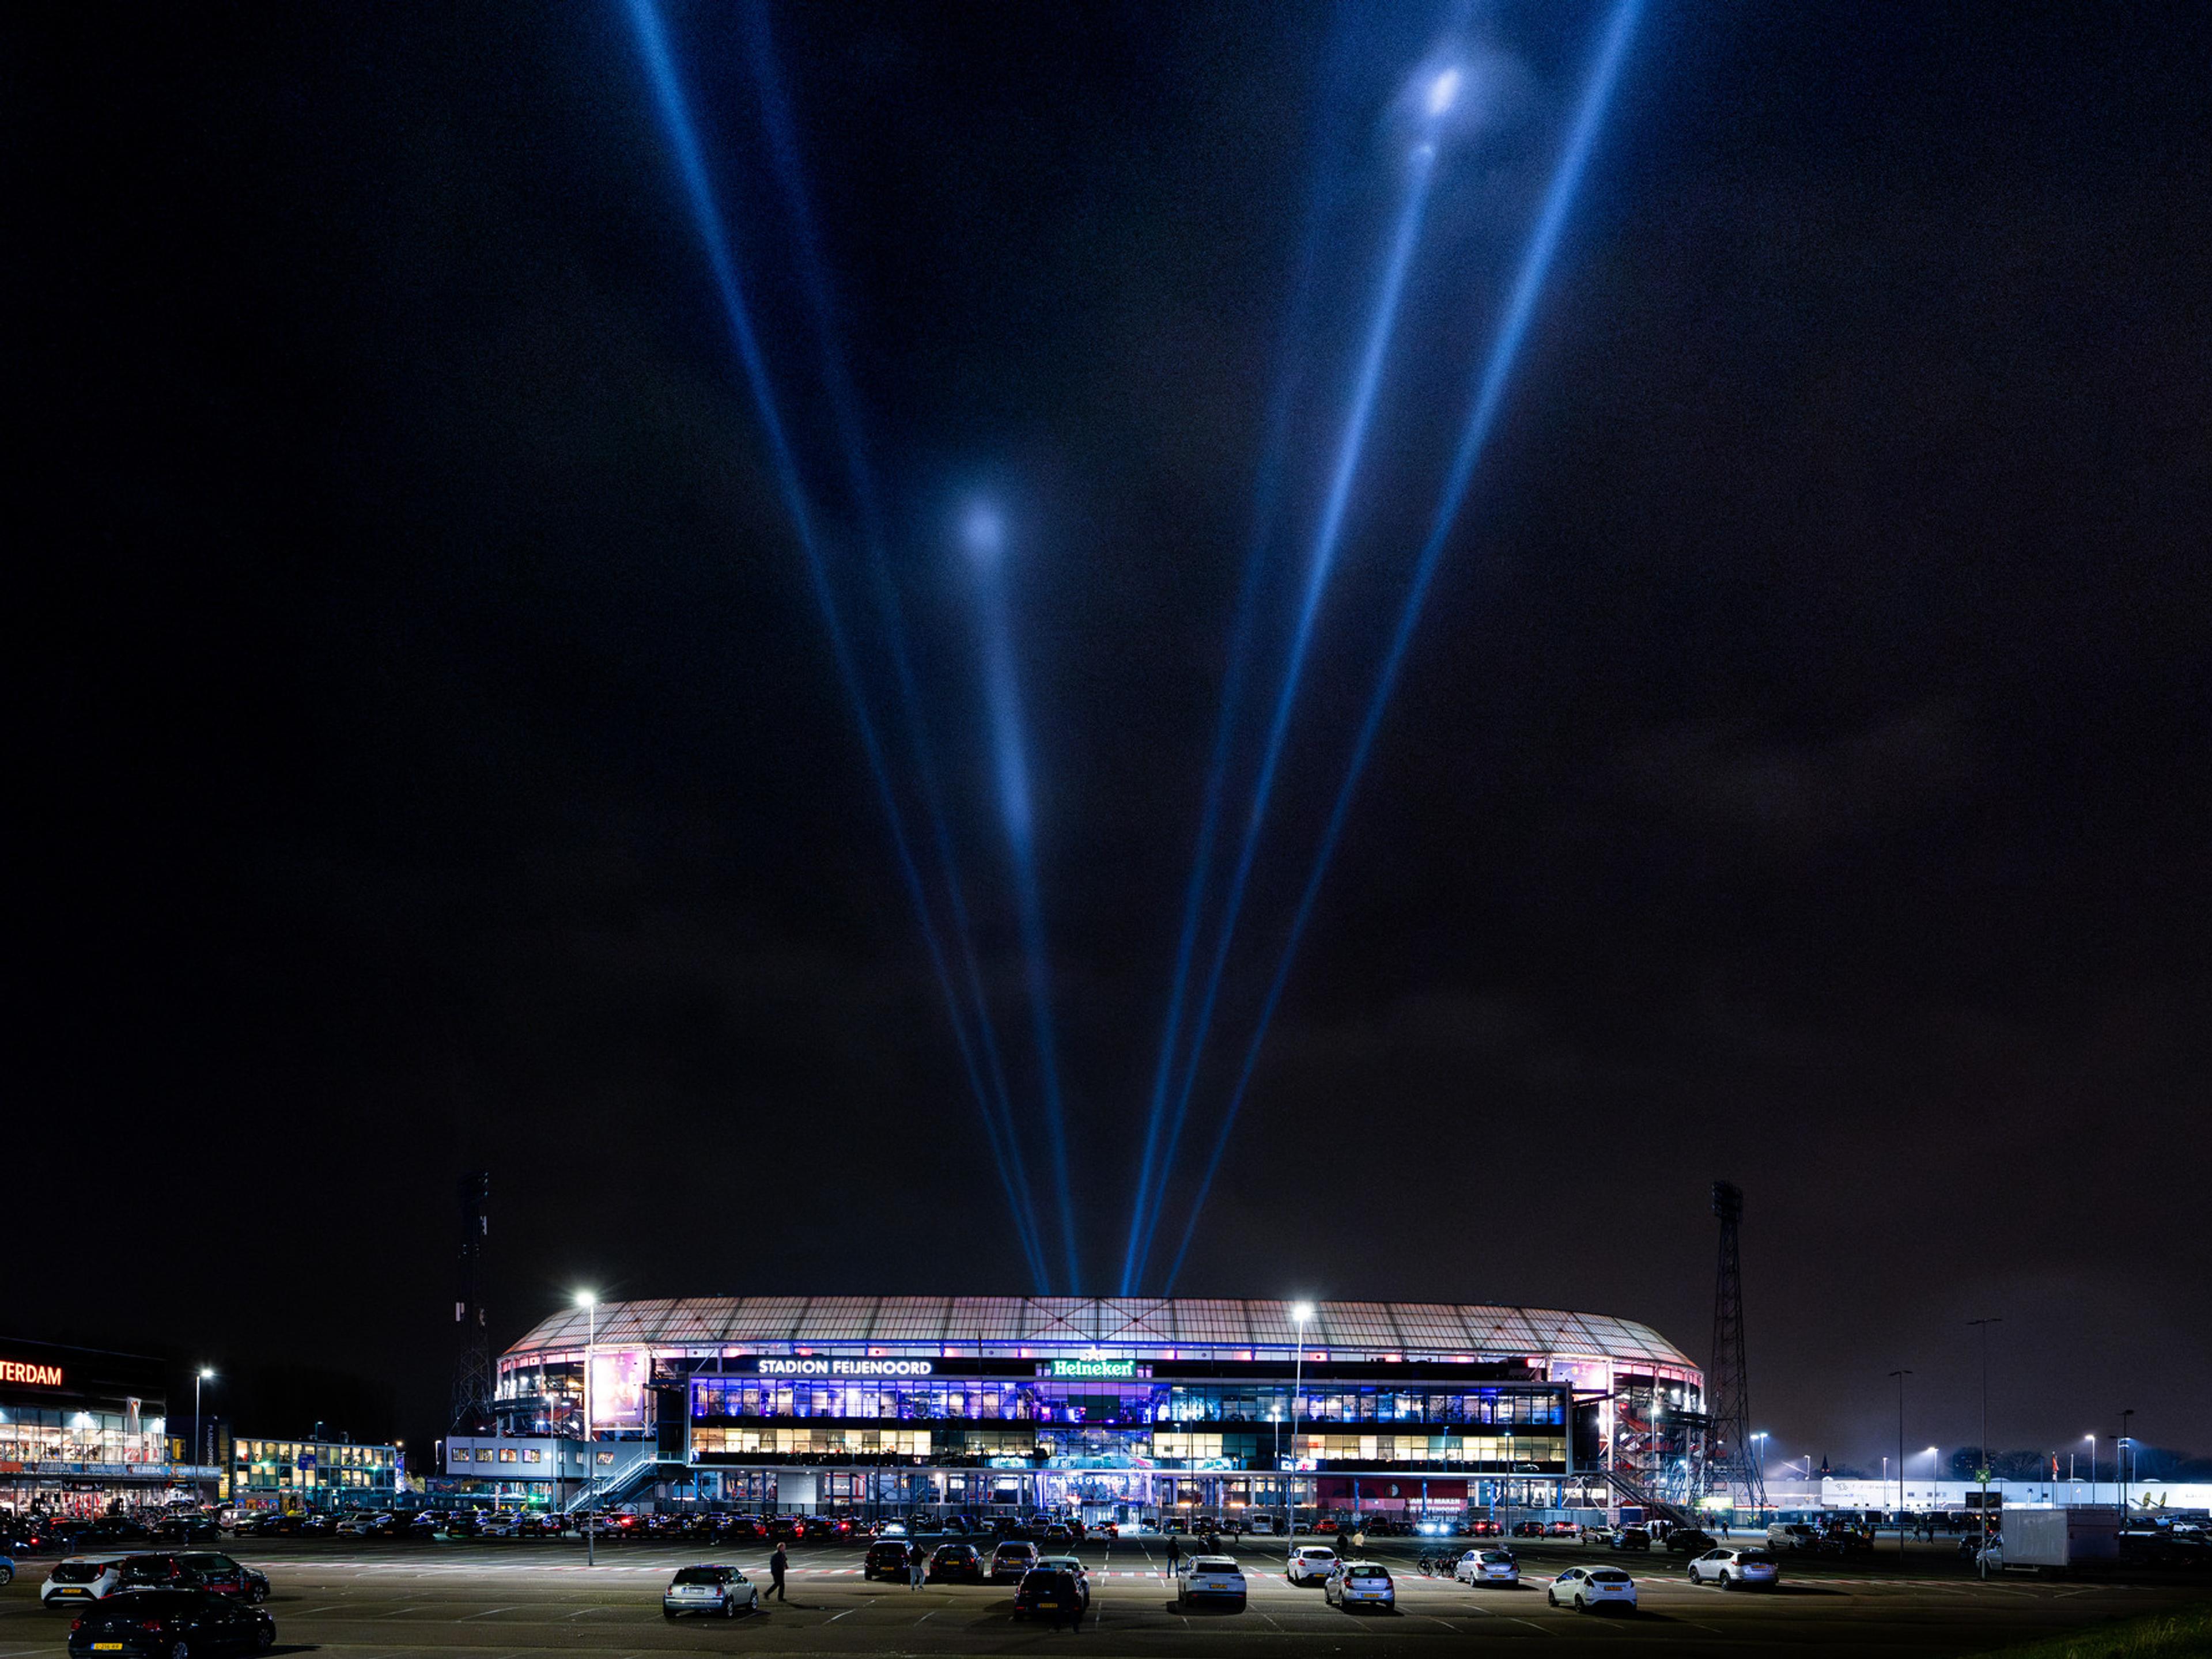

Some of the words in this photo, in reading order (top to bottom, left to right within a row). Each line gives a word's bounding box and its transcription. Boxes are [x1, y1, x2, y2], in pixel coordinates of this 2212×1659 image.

[758, 1360, 829, 1374] STADION
[833, 1361, 932, 1375] FEIJENOORD
[1054, 1360, 1133, 1376] Heineken
